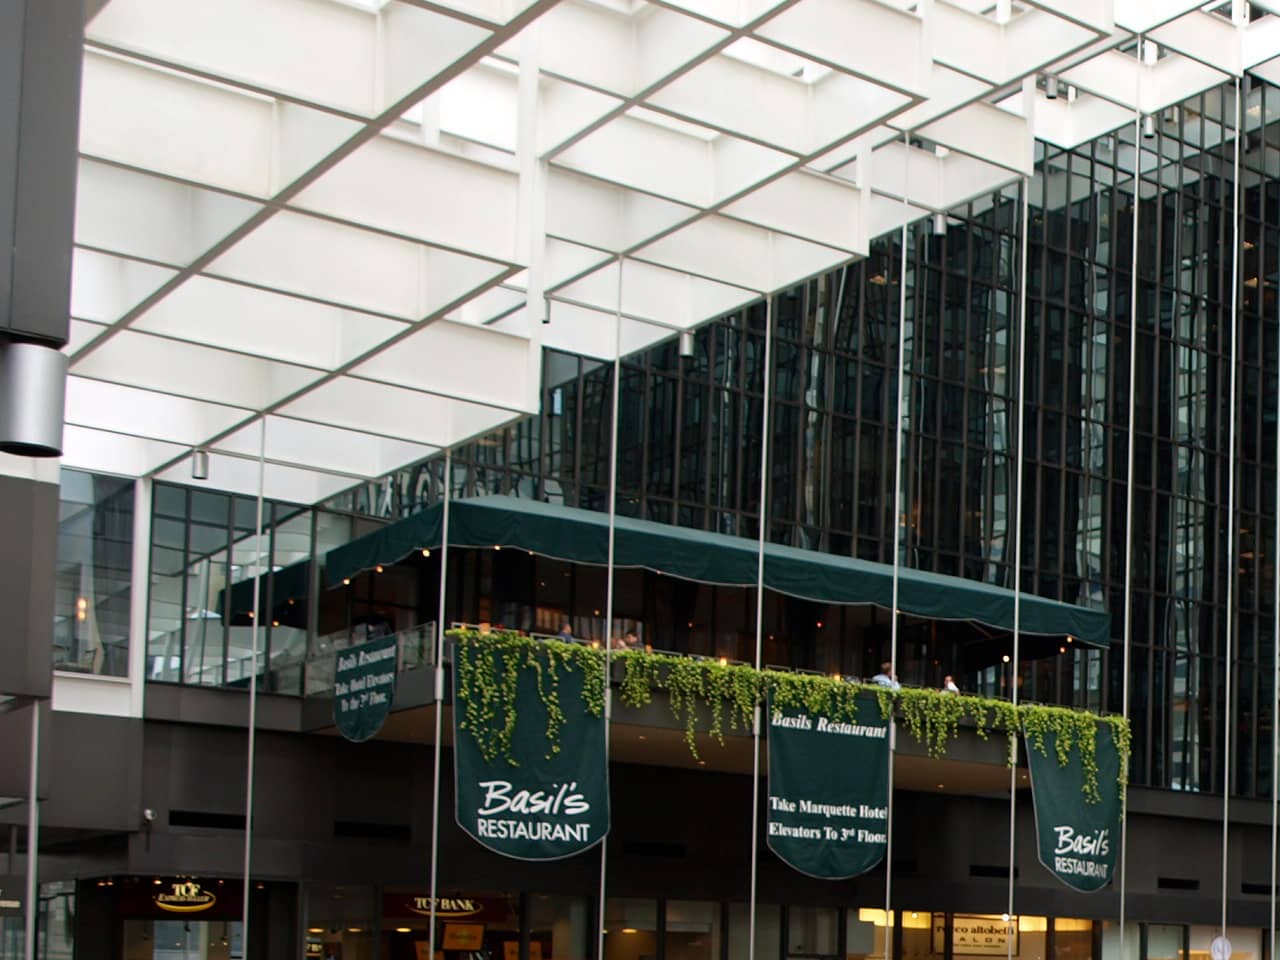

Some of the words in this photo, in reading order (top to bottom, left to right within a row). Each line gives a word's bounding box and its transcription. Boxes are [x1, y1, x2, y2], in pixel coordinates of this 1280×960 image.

[771, 710, 812, 730] Basils
[816, 717, 887, 739] Restaurant
[478, 780, 590, 816] Basil's
[769, 796, 797, 812] Take
[799, 799, 857, 818] Marquette
[859, 805, 888, 819] Hotel
[477, 818, 591, 842] RESTAURANT
[768, 822, 821, 839] Elevators
[823, 827, 839, 840] To
[1053, 825, 1110, 856] Basil's
[1055, 856, 1108, 878] RESTAURANT
[172, 883, 201, 896] TCF
[441, 898, 475, 911] BANK
